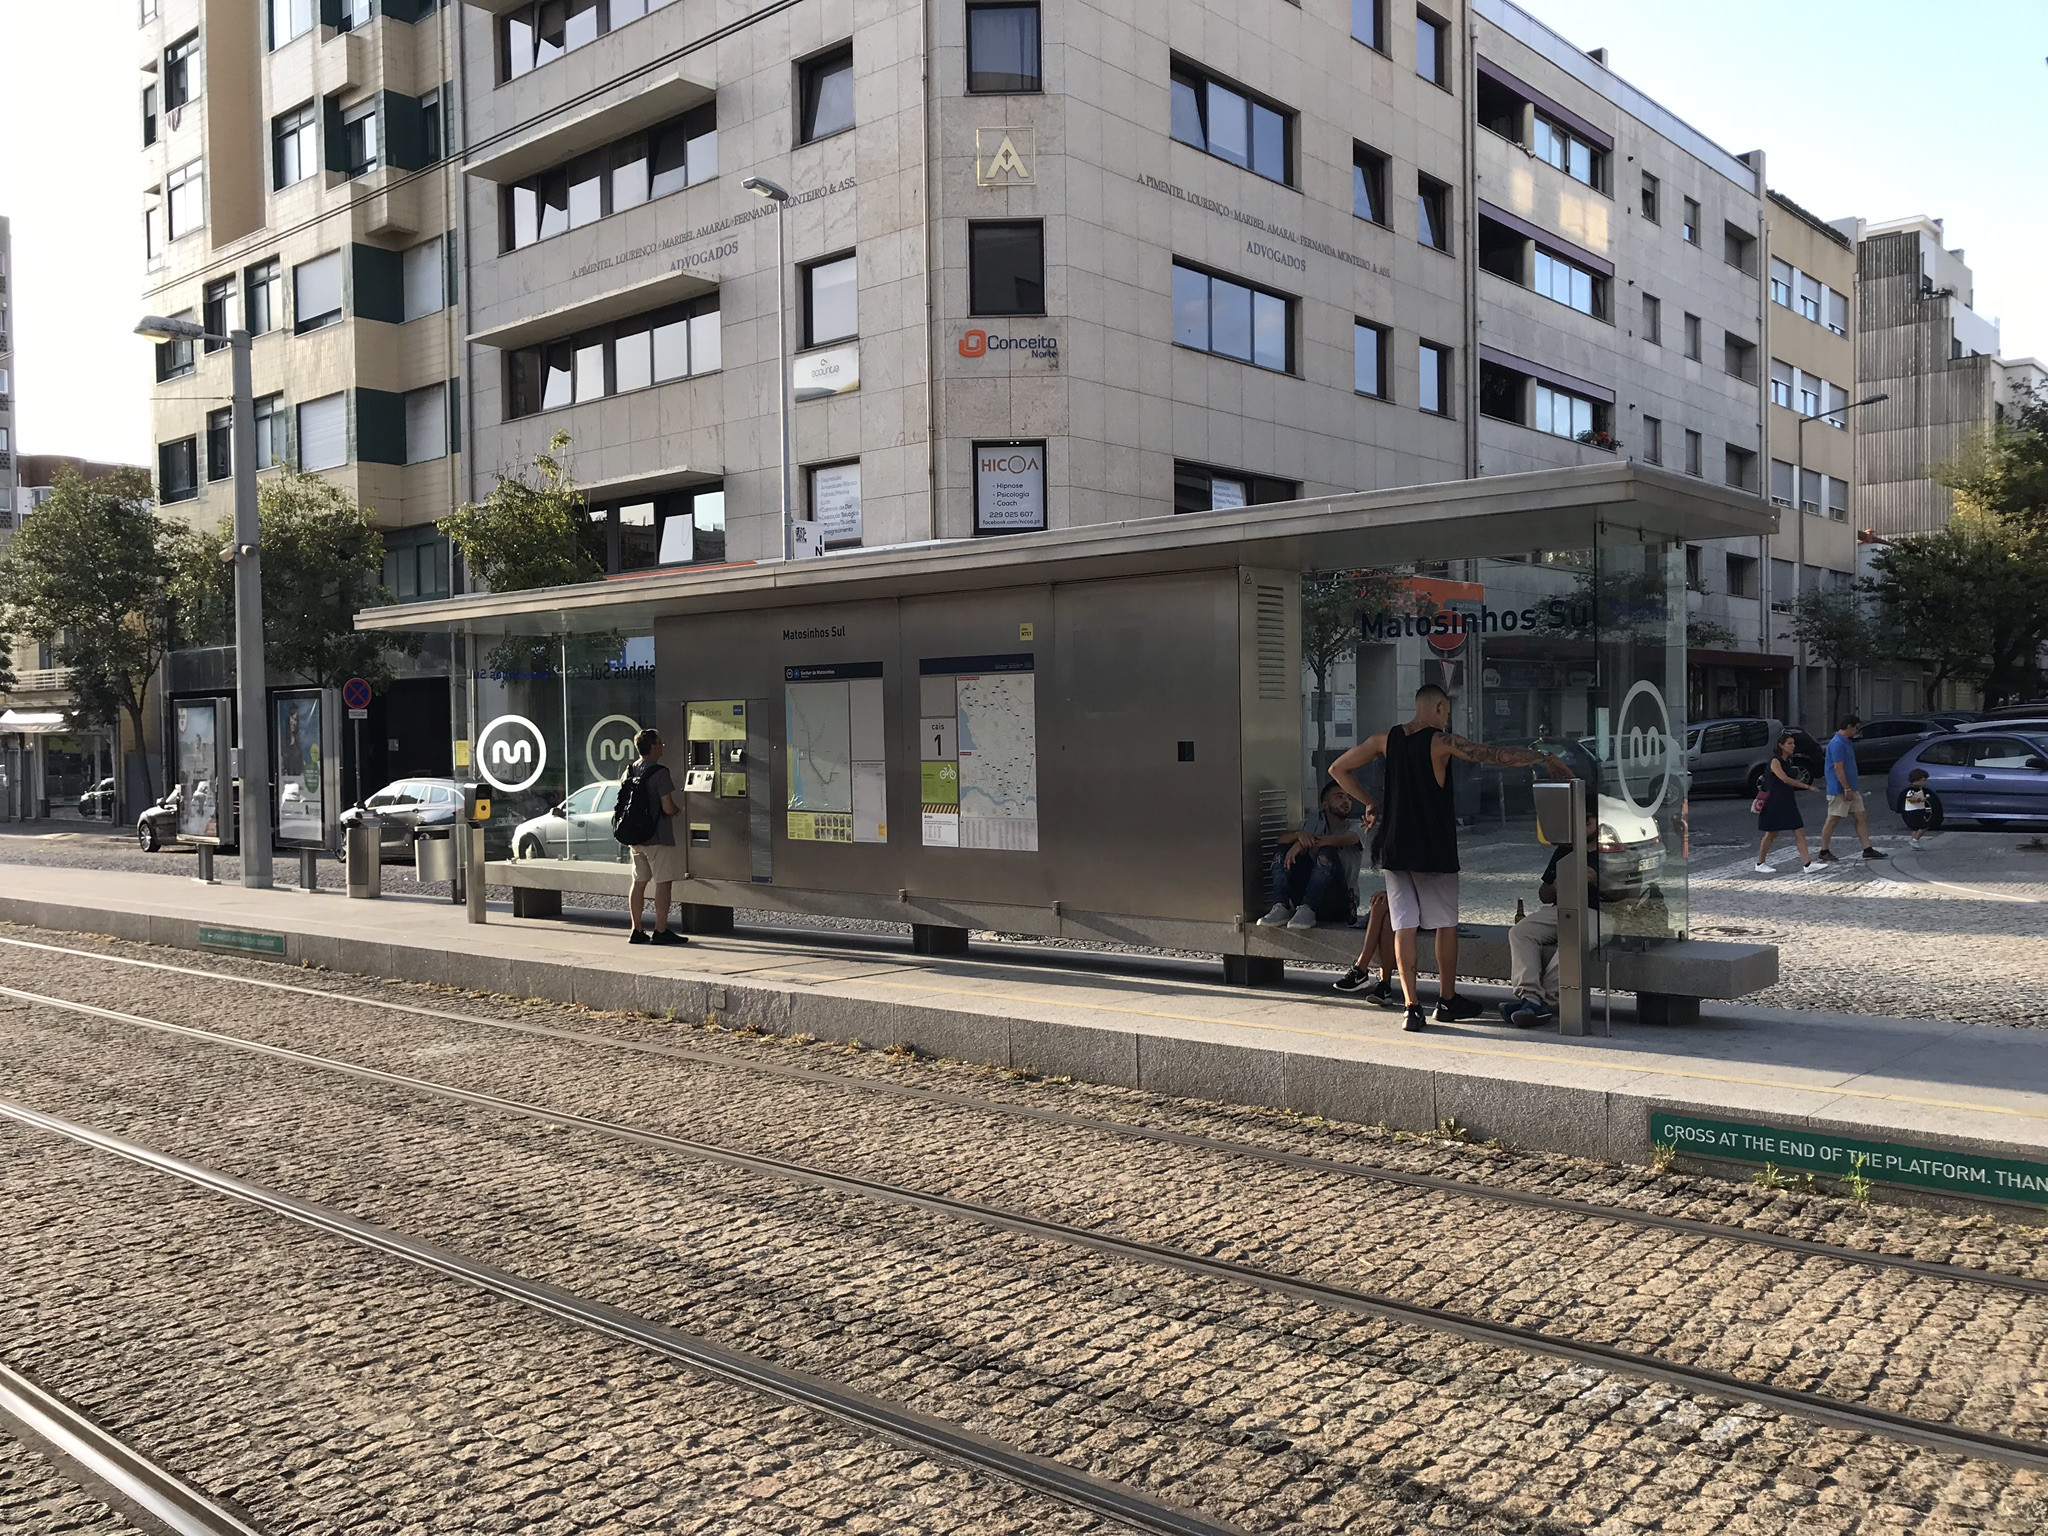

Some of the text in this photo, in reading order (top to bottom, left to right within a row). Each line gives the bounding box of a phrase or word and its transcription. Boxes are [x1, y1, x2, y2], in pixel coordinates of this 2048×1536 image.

[616, 243, 656, 265] LOURENÇO
[662, 231, 695, 251] MARIBEL
[697, 219, 730, 238] AMARAL
[734, 203, 778, 226] FERNANDA
[829, 183, 837, 194] &
[1188, 192, 1229, 217] LOURENÇO
[1234, 210, 1266, 231] MARIBEL
[1267, 223, 1297, 243] AMARAL
[1300, 235, 1336, 258] FERNANDA
[1337, 249, 1370, 271] MONTEIRO
[670, 241, 739, 272] ADVOGADOS
[1246, 240, 1306, 272] ADVOGADOS
[987, 334, 1057, 350] Conceito
[1031, 350, 1058, 359] Norte
[982, 455, 1039, 474] HICOA
[996, 482, 1024, 490] Hipnose
[996, 491, 1030, 499] Psicologia
[783, 625, 846, 640] Matosinhos Sul
[1361, 605, 1537, 640] Matosinhos
[934, 734, 942, 757] 1
[1664, 1124, 1716, 1144] CROSS
[1719, 1132, 1737, 1147] AT
[1742, 1134, 1775, 1153] THE
[1779, 1140, 1816, 1158] END
[1820, 1146, 1843, 1161] OF
[1847, 1149, 1882, 1168] THE
[1886, 1155, 1991, 1185] PLATFORM.
